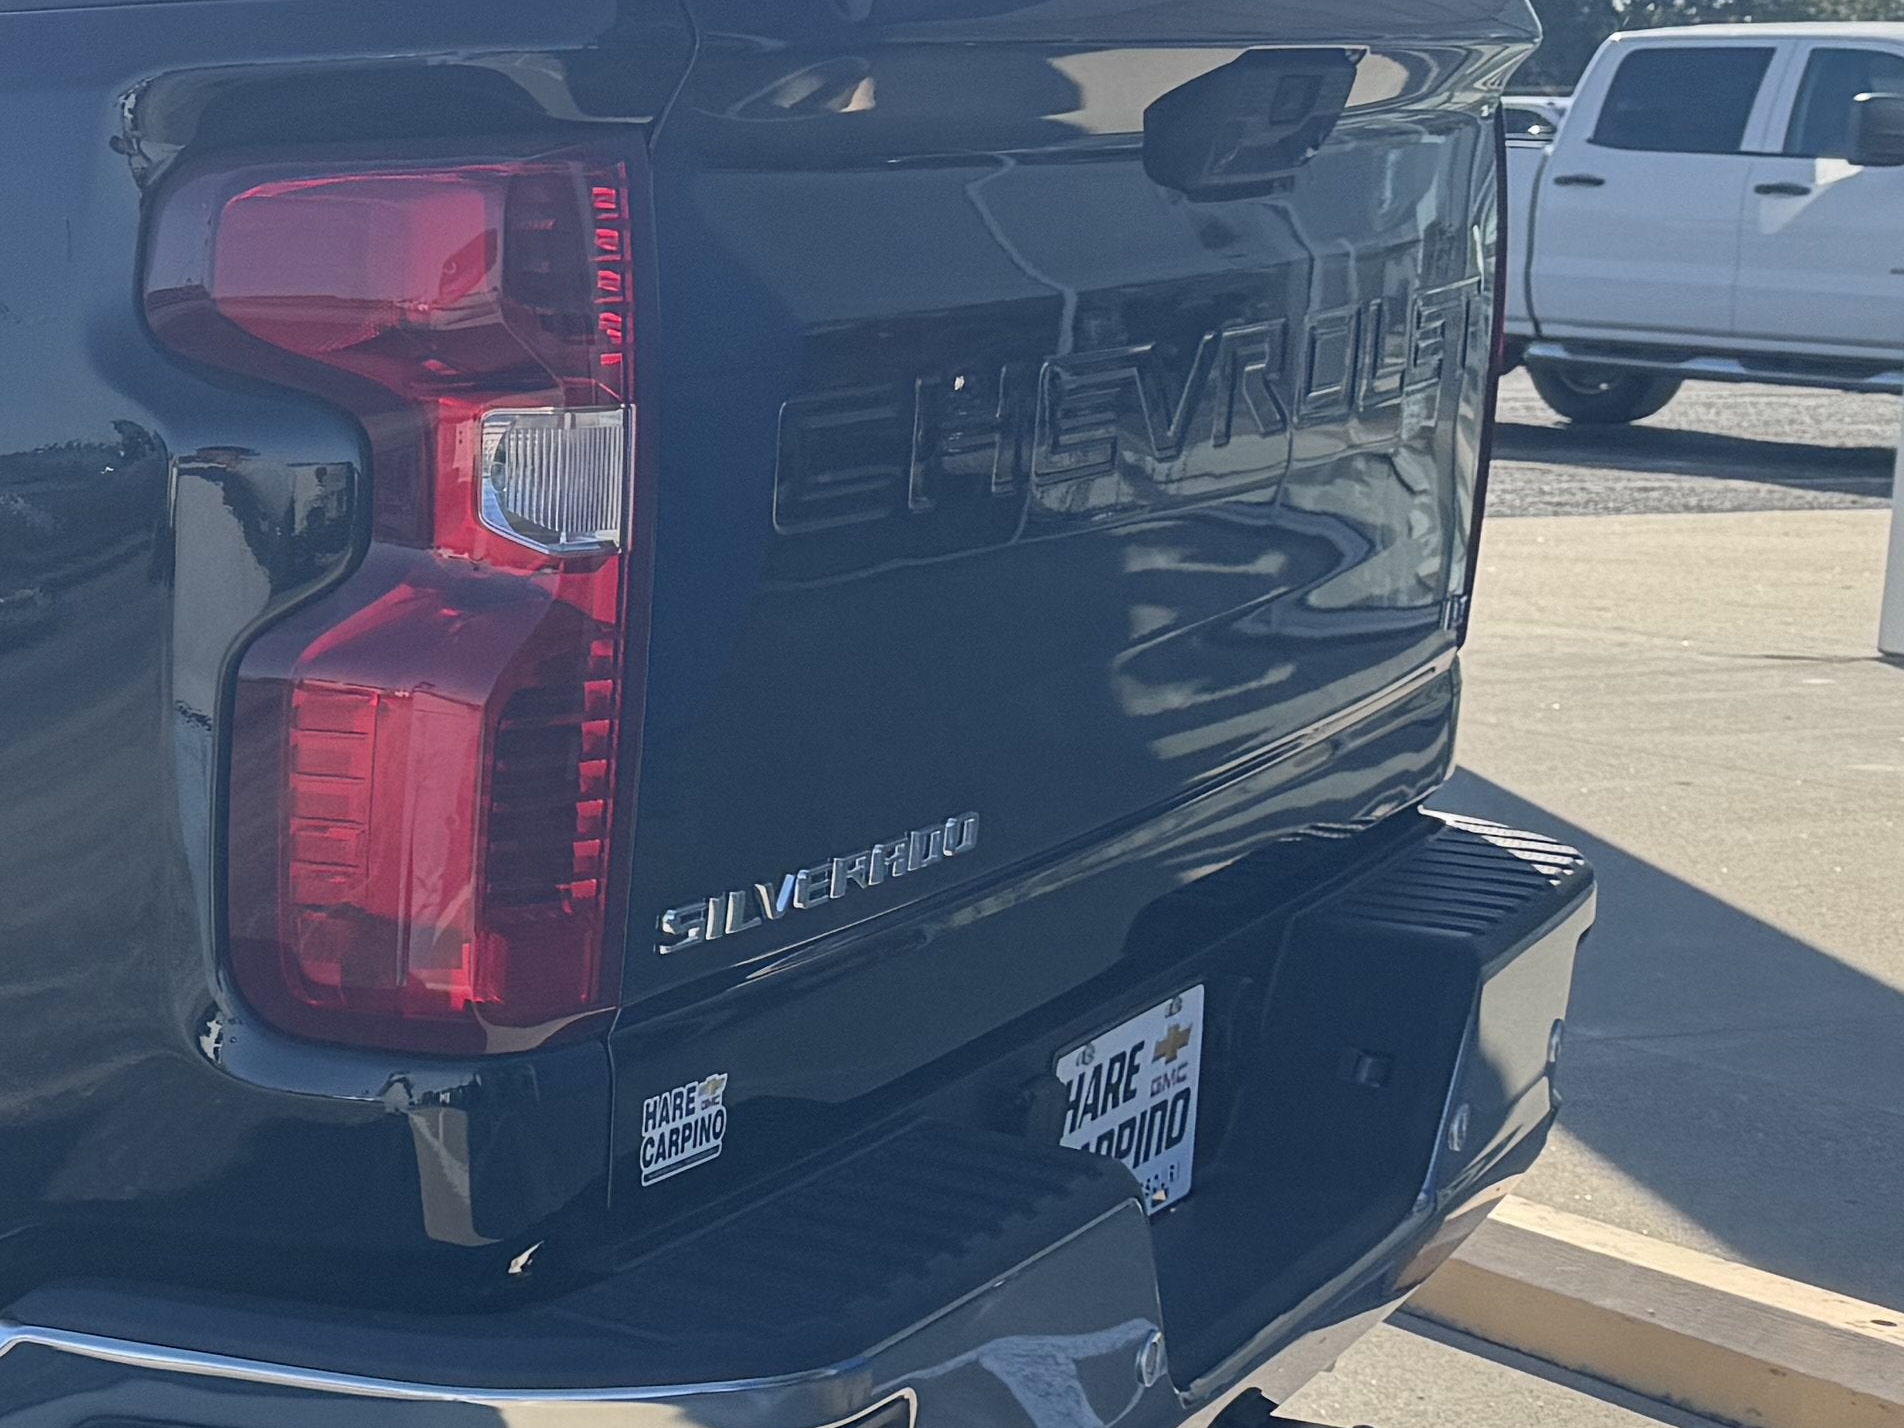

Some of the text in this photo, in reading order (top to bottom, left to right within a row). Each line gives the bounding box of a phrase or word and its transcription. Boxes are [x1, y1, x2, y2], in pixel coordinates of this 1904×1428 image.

[772, 275, 1482, 535] CHEVROLET
[654, 811, 980, 956] SILVERADO
[644, 1085, 697, 1133] HARE
[1065, 1039, 1146, 1135] HARE
[1149, 1061, 1189, 1098] GMC
[642, 1110, 725, 1168] CARPINO
